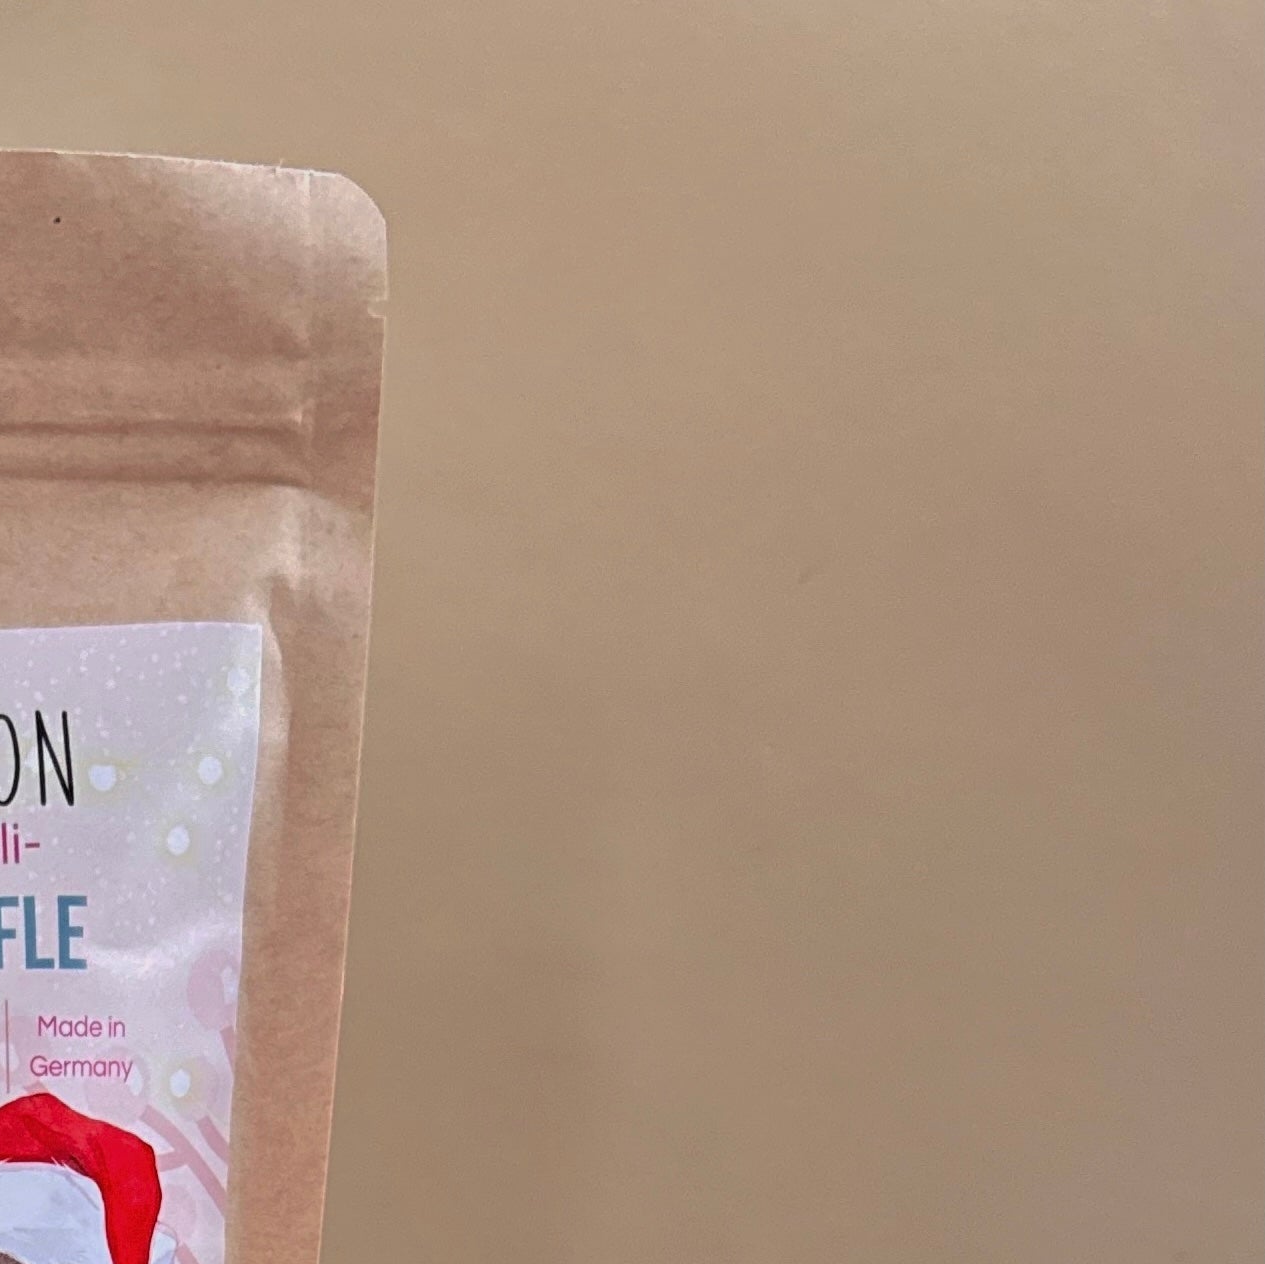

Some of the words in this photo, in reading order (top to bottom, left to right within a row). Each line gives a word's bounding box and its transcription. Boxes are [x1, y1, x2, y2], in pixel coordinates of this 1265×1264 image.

[36, 1014, 103, 1039] Made
[107, 1015, 127, 1038] in
[29, 1055, 133, 1082] Germany
